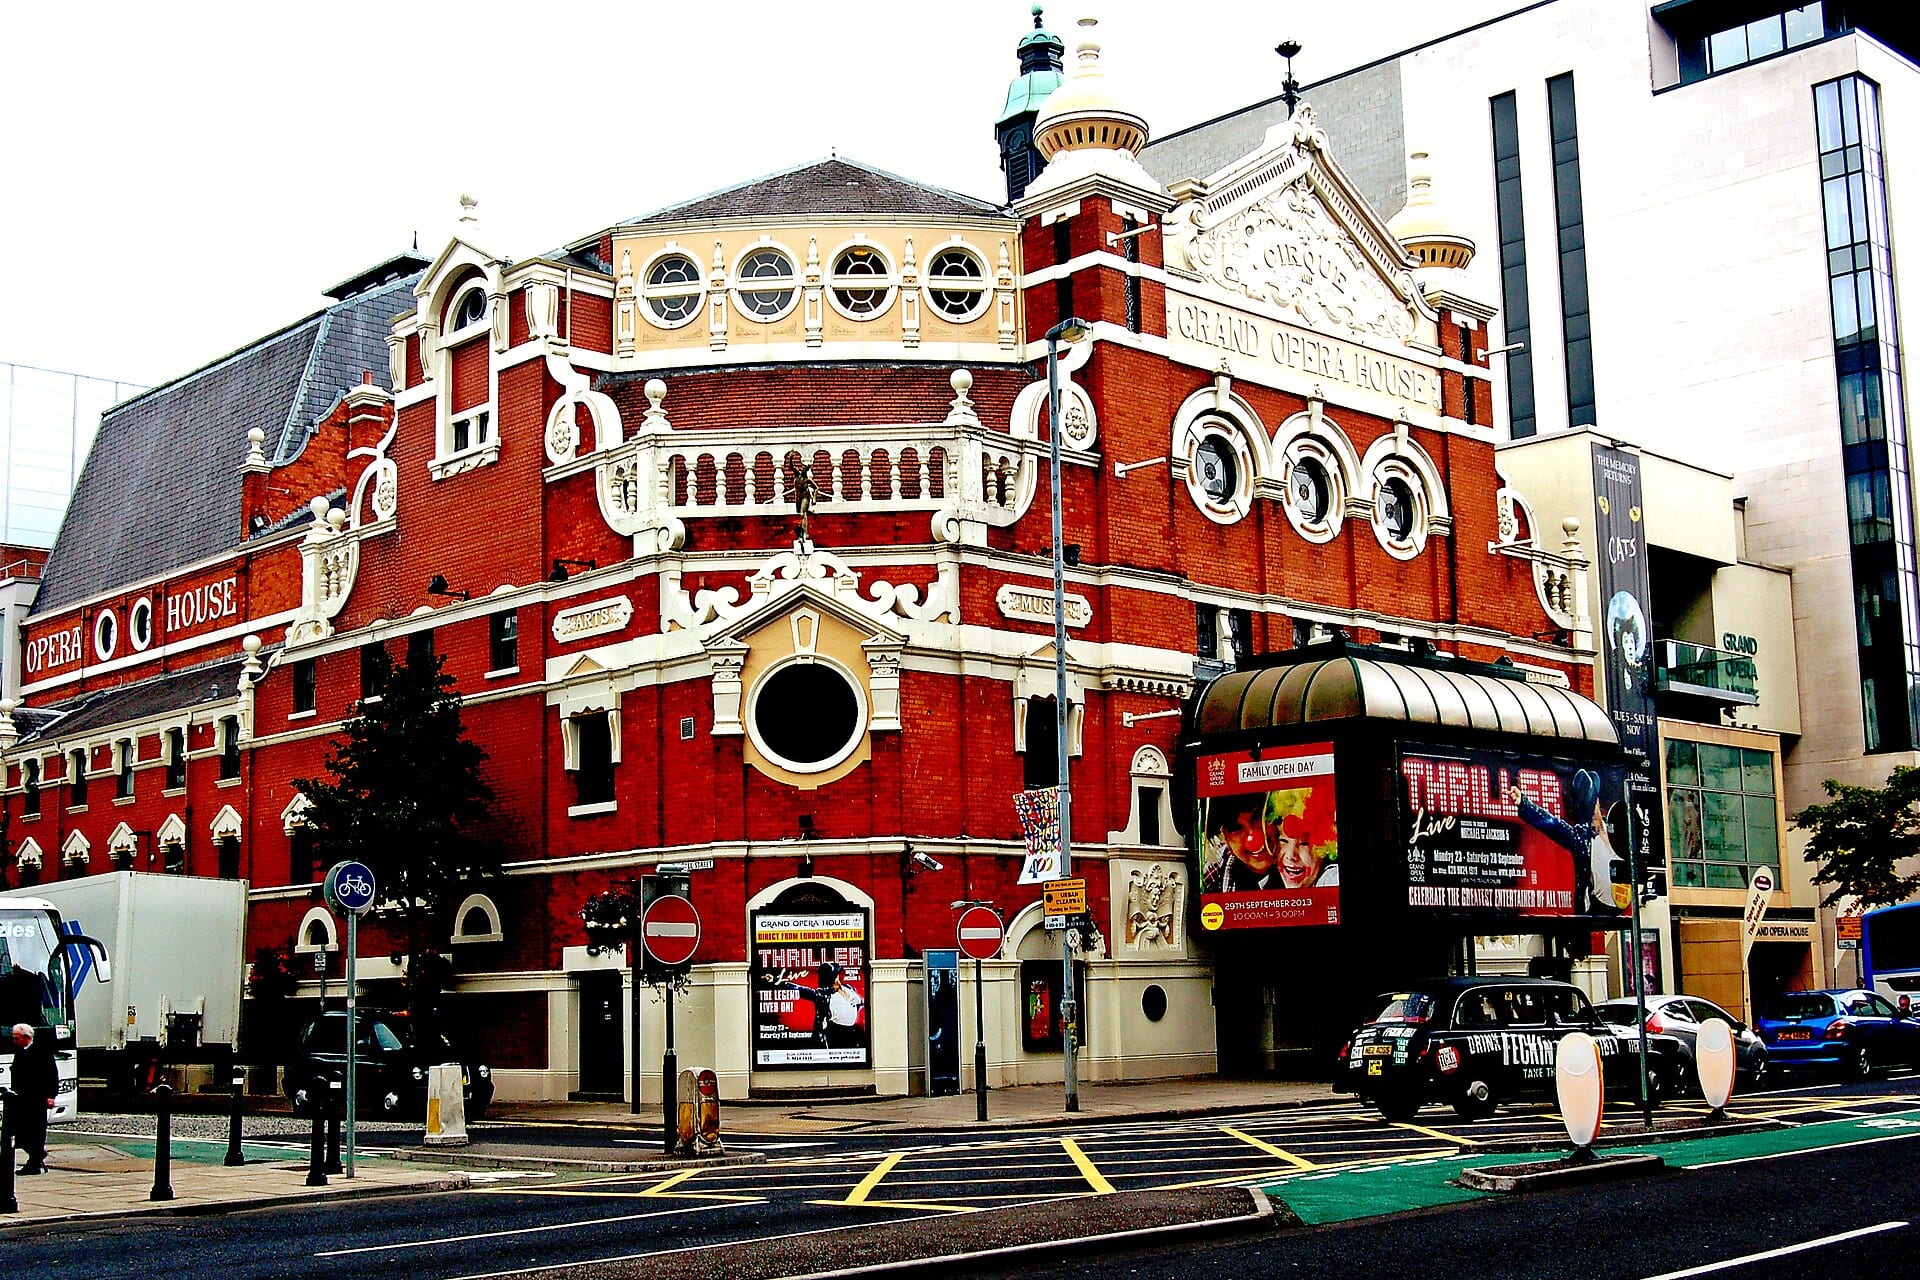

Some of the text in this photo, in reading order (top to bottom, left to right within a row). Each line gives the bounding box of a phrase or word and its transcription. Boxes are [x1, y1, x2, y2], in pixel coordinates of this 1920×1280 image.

[1263, 243, 1348, 295] CIRQUE
[1177, 301, 1428, 405] GRAND OPERA HOUSE
[1597, 454, 1637, 475] THE MEMORY
[1604, 468, 1632, 486] RETURNS
[1608, 535, 1637, 564] CATS
[26, 576, 237, 674] OPERA HOUSE
[575, 609, 610, 632] ARTS
[1723, 632, 1758, 656] GRAND
[1626, 724, 1641, 736] NOV
[1242, 761, 1315, 779] FAMILY OPEN DAY
[1403, 761, 1561, 822] THRILLER
[1409, 807, 1456, 844] Live
[1434, 850, 1453, 864] Monday
[1498, 853, 1524, 866] September
[1029, 857, 1053, 879] 400
[1246, 900, 1290, 909] SEPTEMBER
[1291, 899, 1312, 907] 2013
[1409, 886, 1572, 908] CELEBRATE THE GREATEST ENTERTAINER OF ALL TIME
[761, 920, 790, 928] GRAND
[792, 920, 819, 928] OPERA
[1756, 927, 1809, 936] AND OPERA HOUSE
[758, 933, 779, 941] DIRECT
[800, 932, 830, 940] LONDON'S
[832, 931, 848, 939] WEST
[758, 946, 862, 968] THRILLER
[774, 968, 809, 986] Live
[760, 989, 800, 1001] THE LEGEND
[760, 1002, 793, 1013] LIVES ON!
[760, 1032, 780, 1040] Saturday
[1467, 1033, 1501, 1054] DRINK
[1501, 1032, 1554, 1066] FECKIN
[1523, 1068, 1544, 1079] TAKE
